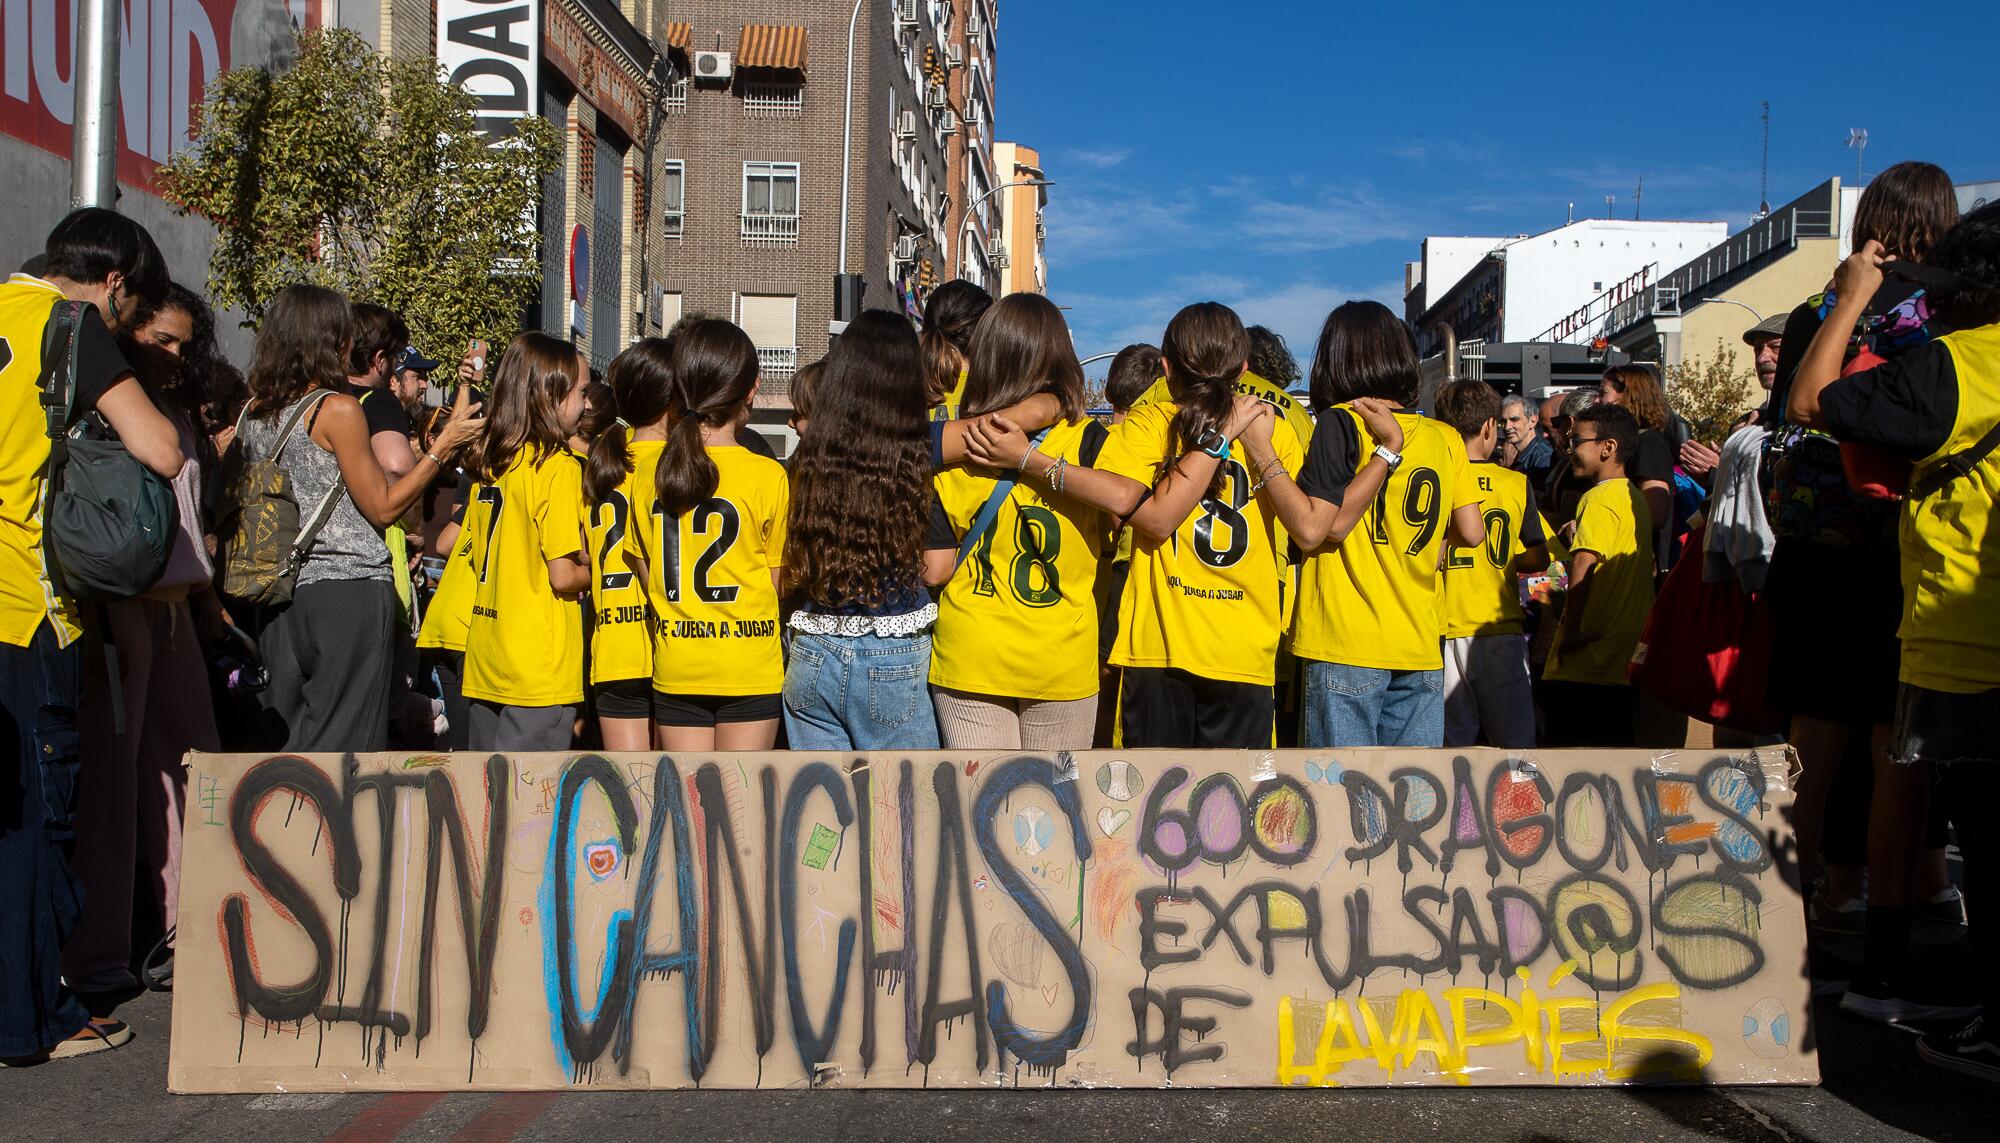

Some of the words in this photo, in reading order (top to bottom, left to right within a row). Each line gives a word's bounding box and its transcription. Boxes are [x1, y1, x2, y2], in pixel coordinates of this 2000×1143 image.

[477, 485, 504, 584] 7
[1171, 460, 1250, 568] 8
[1371, 467, 1441, 556] 19
[1477, 476, 1493, 492] EL
[652, 497, 741, 603] 12
[968, 500, 1063, 608] 18
[1208, 589, 1215, 599] A
[1216, 589, 1244, 600] JUGAR
[671, 619, 716, 638] JUEGA
[719, 620, 731, 638] A
[733, 619, 775, 638] JUGAR
[1138, 766, 1318, 872] 600
[1342, 756, 1774, 875] DRAGONES
[219, 754, 510, 1042] SIN
[541, 752, 1097, 1078] CANCHAS
[1136, 866, 1765, 991] EXPULSAD@S
[1126, 986, 1252, 1070] DE
